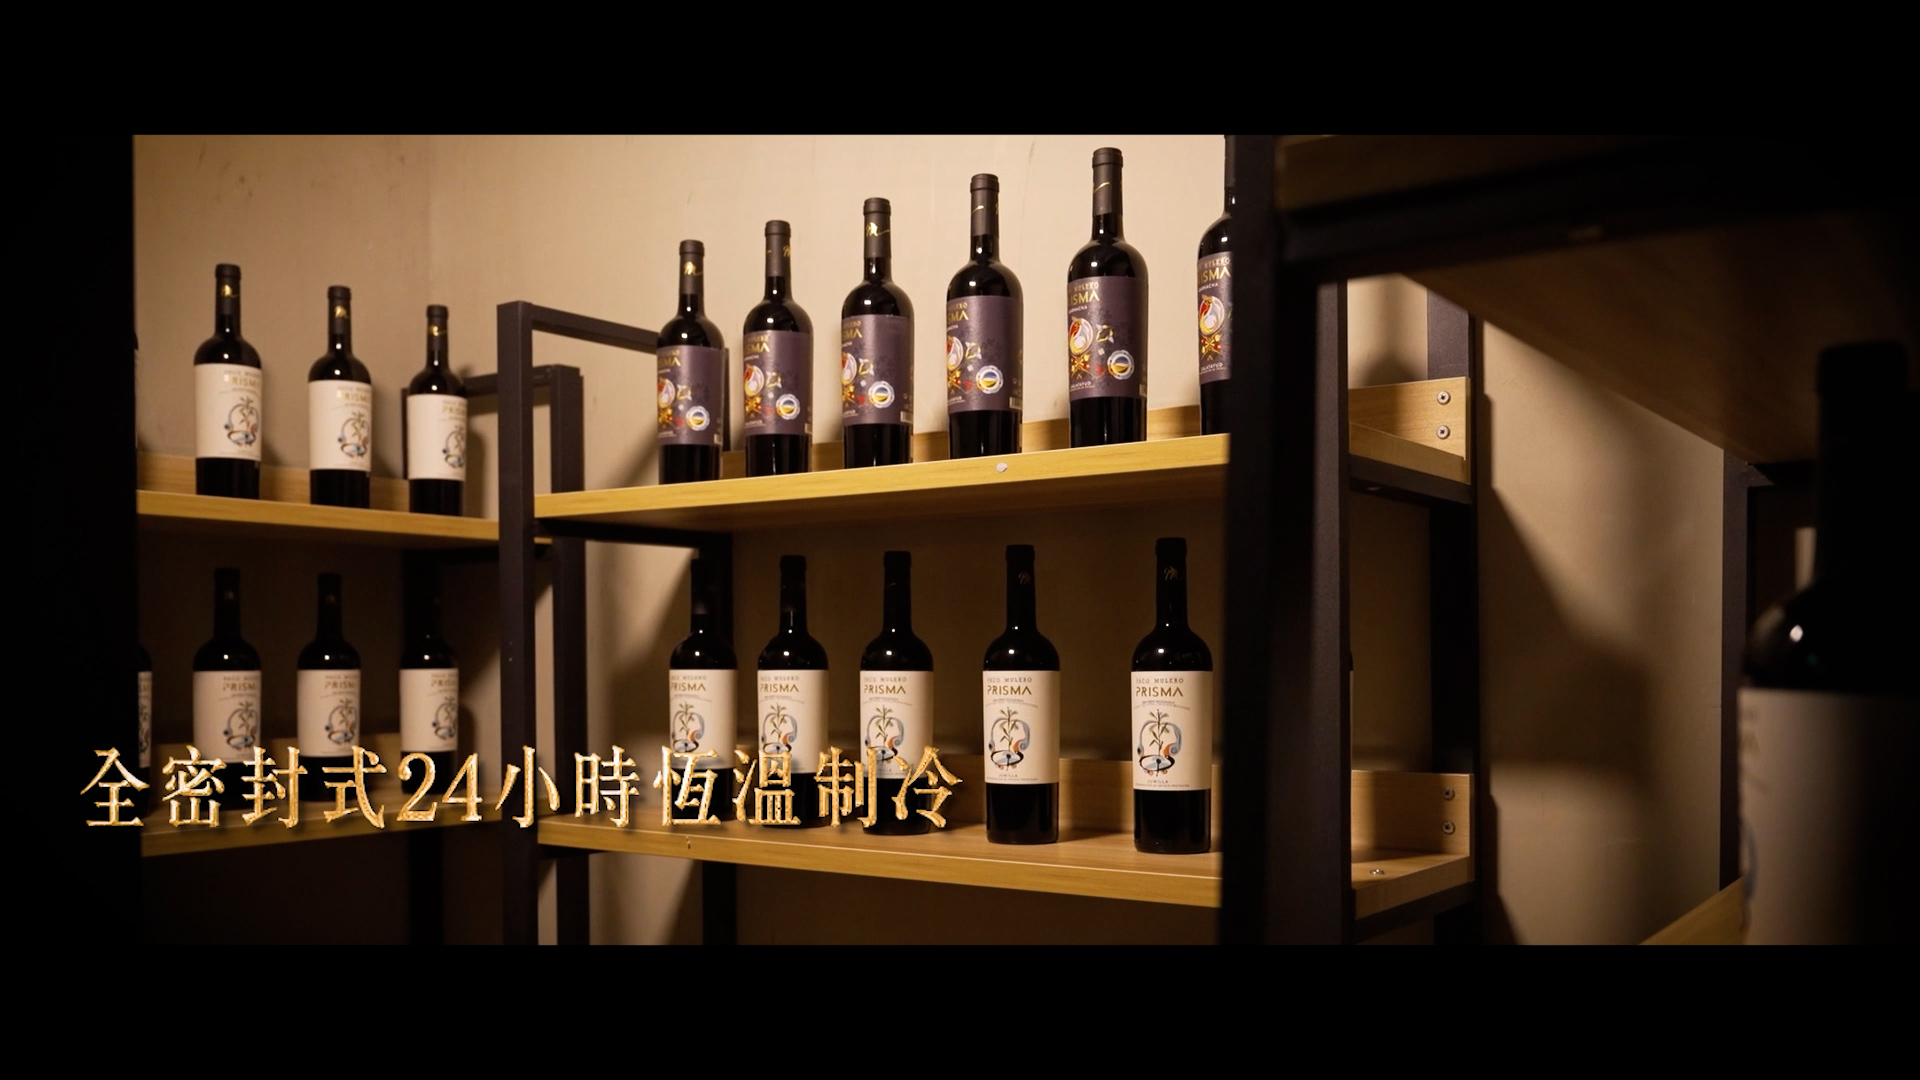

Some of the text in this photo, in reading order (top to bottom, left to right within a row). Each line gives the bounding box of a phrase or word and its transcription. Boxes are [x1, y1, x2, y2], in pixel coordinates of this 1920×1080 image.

[670, 682, 707, 692] PRISMA
[760, 683, 800, 693] PRISMA
[864, 684, 907, 695] PRISMA
[987, 685, 1033, 696] PRISMA
[1136, 686, 1184, 698] PRISMA
